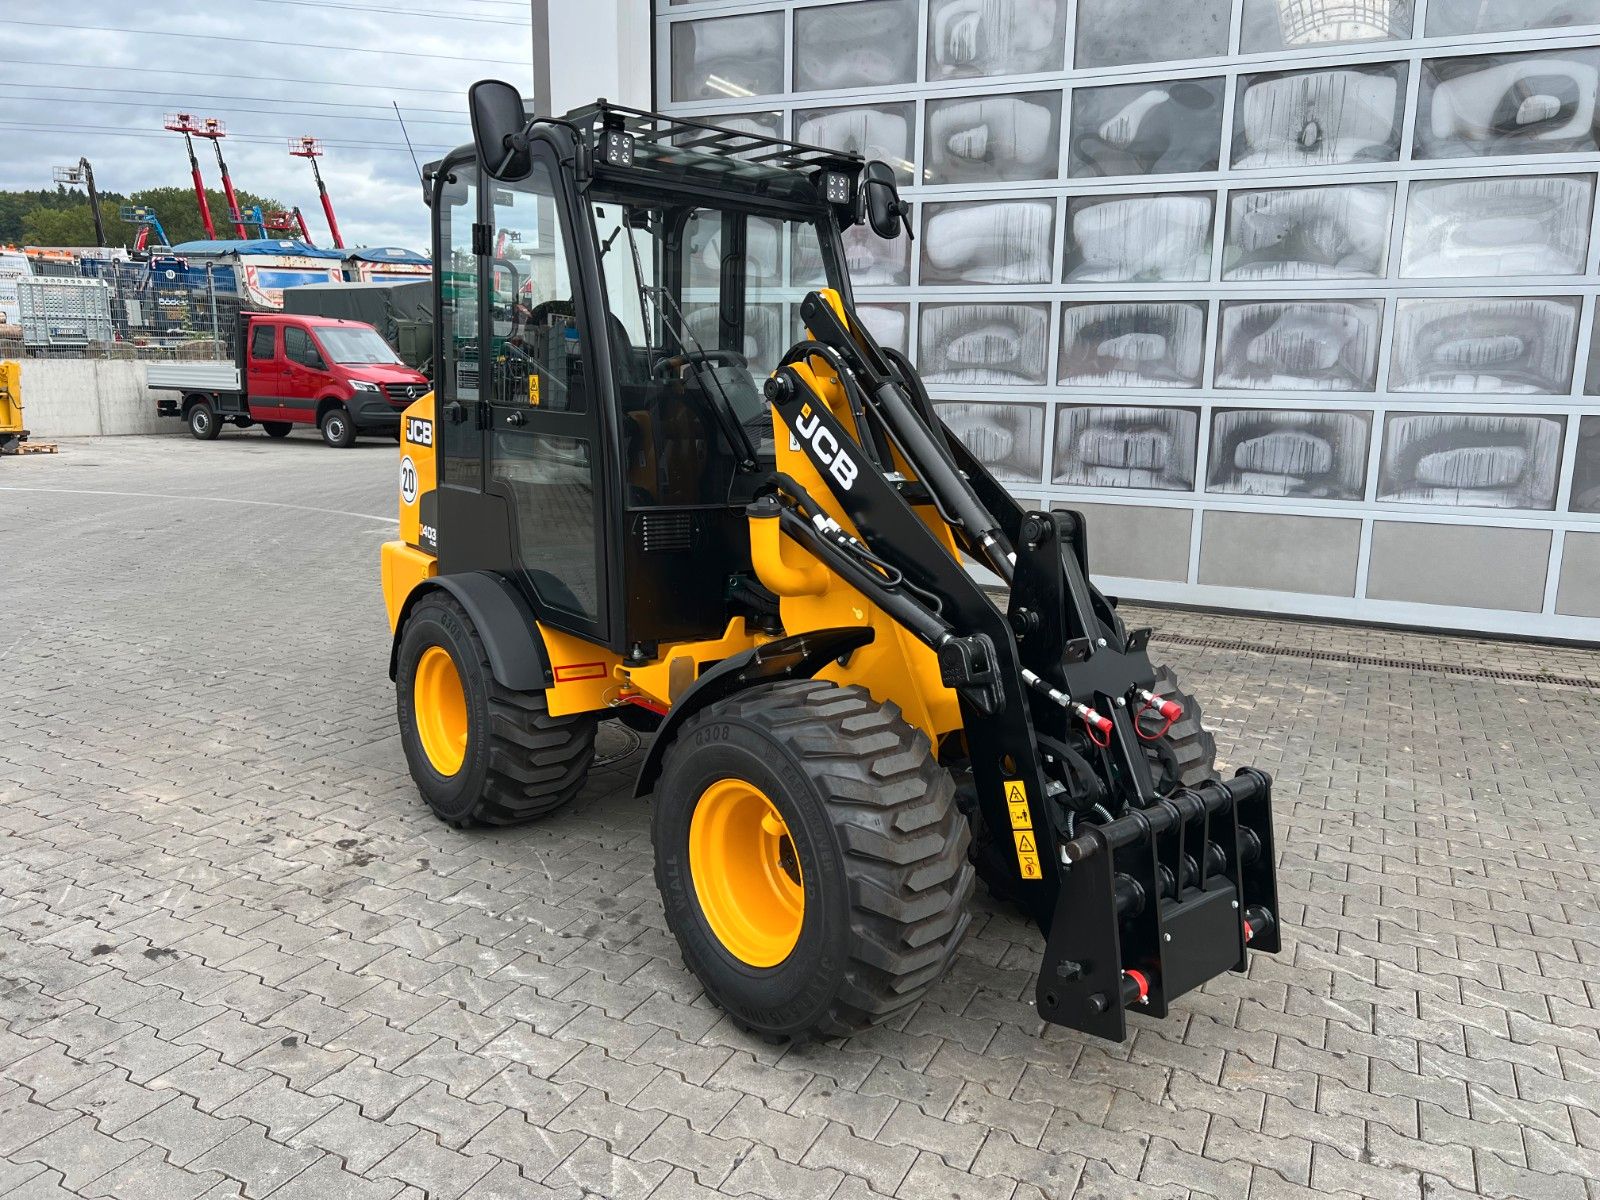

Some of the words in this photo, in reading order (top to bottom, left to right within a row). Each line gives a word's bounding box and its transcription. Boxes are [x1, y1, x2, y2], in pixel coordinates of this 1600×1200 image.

[407, 419, 432, 444] JCB
[796, 414, 858, 491] JCB
[403, 467, 414, 494] 20
[666, 854, 690, 913] WALL
